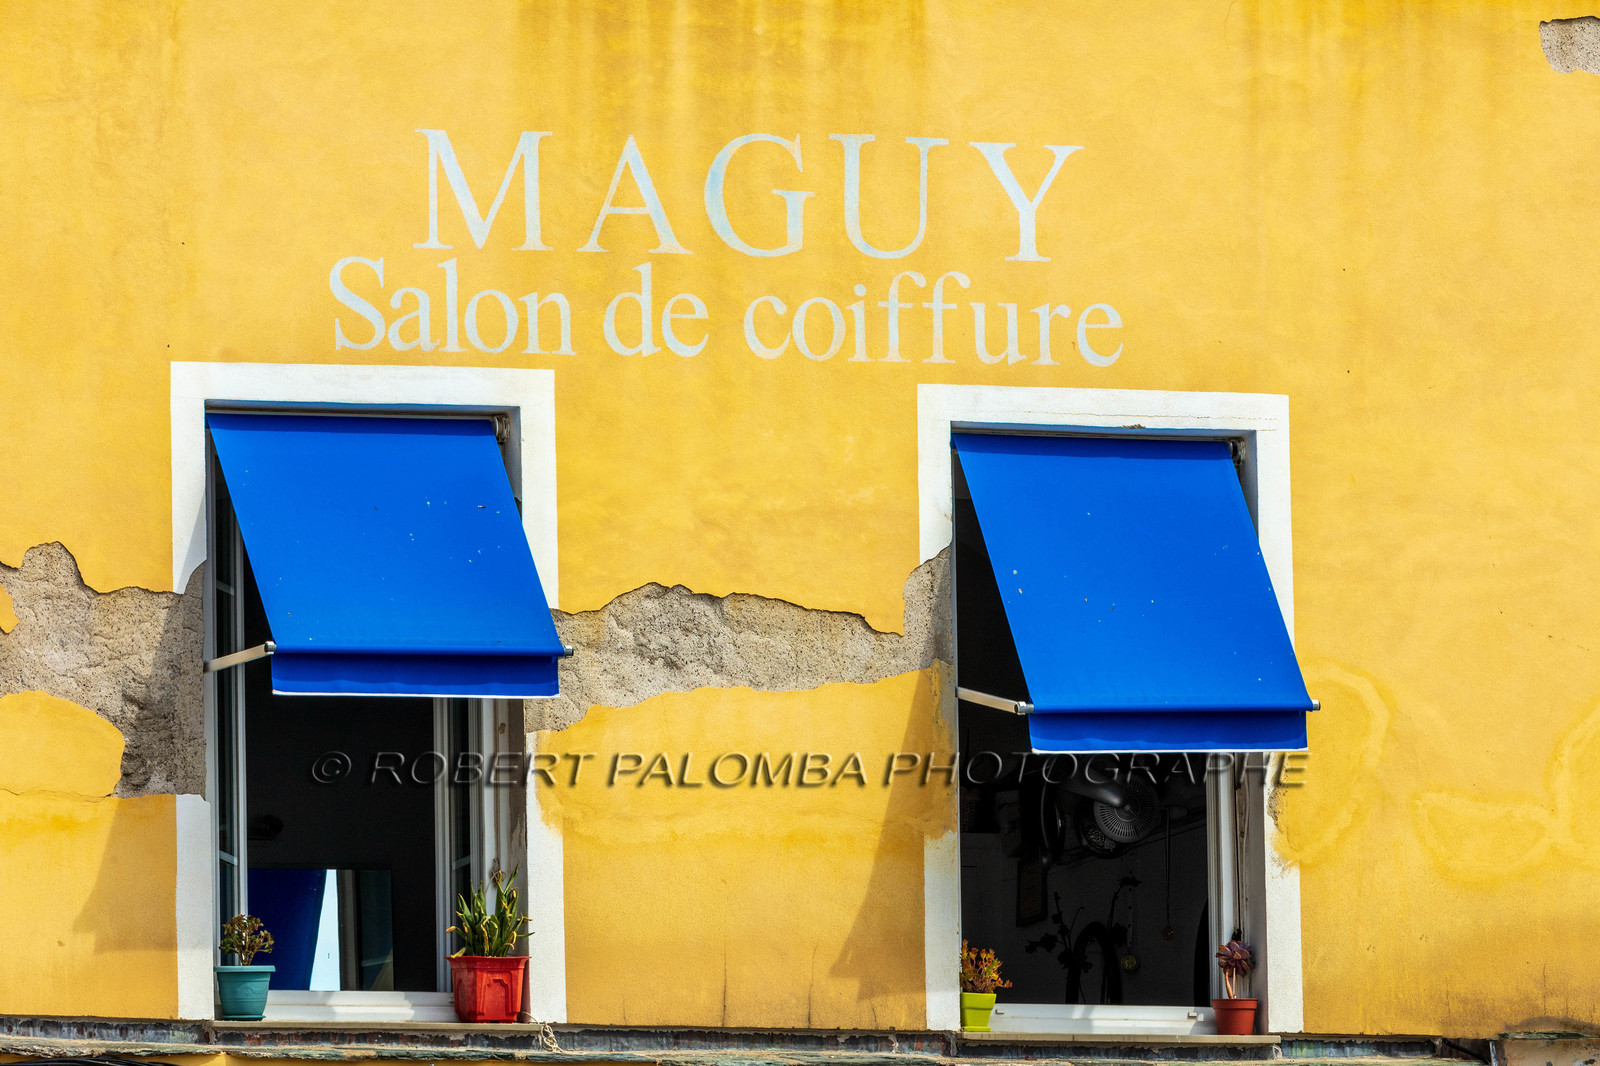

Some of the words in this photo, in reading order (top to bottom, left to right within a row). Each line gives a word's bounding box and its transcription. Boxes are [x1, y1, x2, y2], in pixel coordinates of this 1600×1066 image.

[413, 128, 1085, 263] MAGUY
[328, 256, 577, 356] Salon
[603, 262, 709, 359] de
[743, 270, 1125, 368] coiffure
